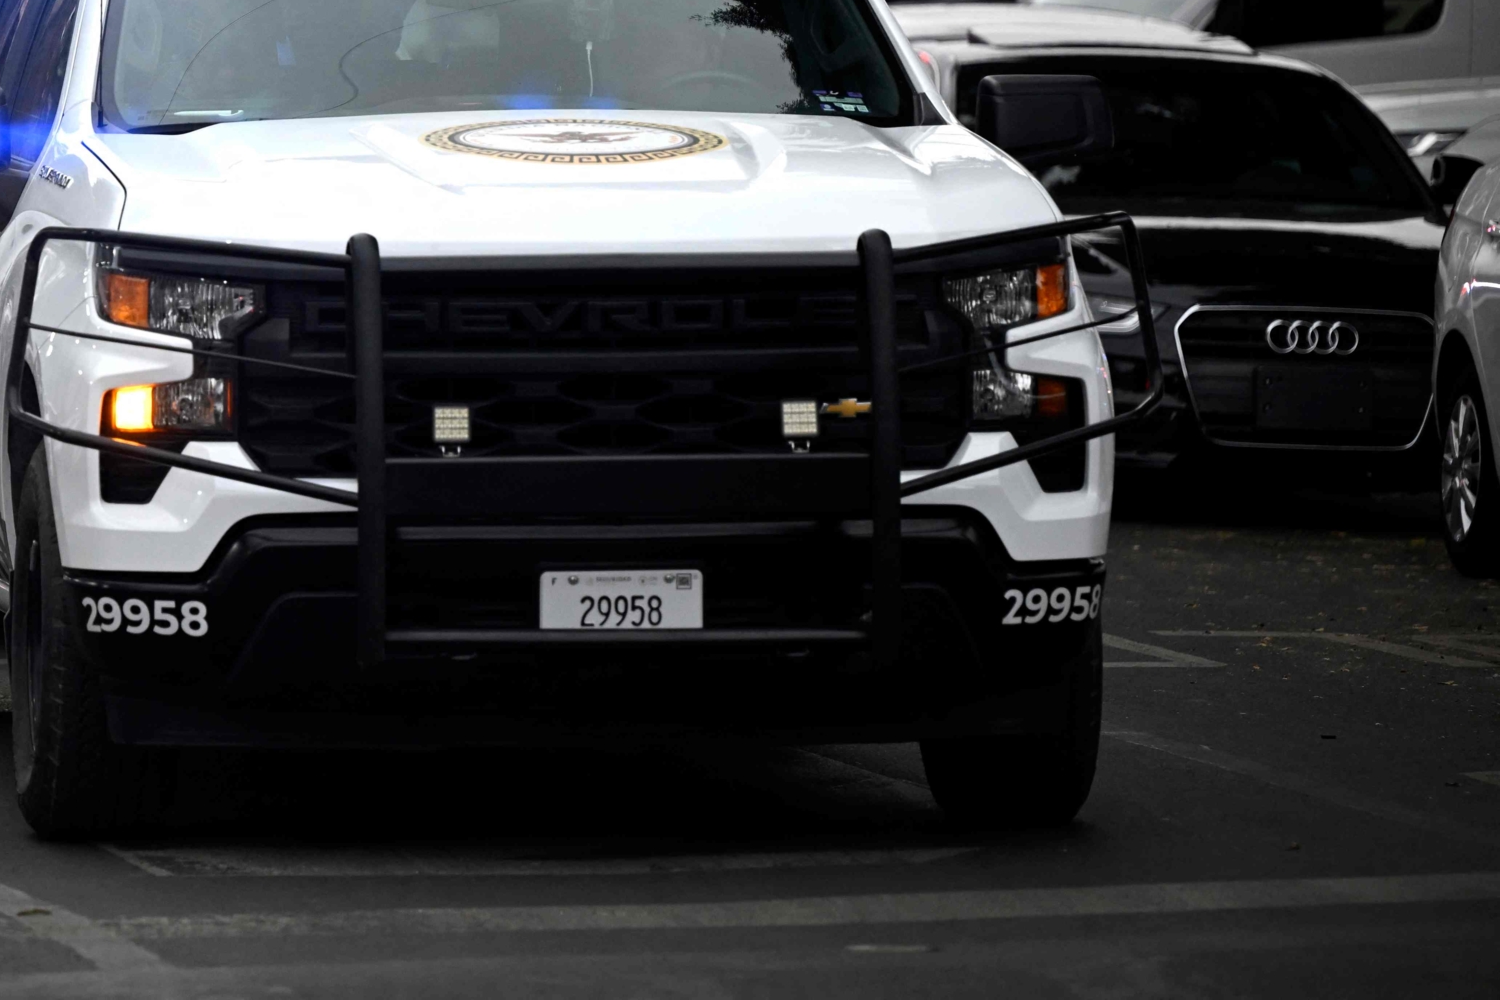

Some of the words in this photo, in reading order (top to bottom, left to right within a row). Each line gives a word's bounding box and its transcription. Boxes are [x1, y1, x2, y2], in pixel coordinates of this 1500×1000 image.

[304, 292, 918, 335] CHEVROLE
[82, 595, 209, 637] 29958
[580, 595, 663, 627] 29958
[1002, 583, 1102, 626] 29958
